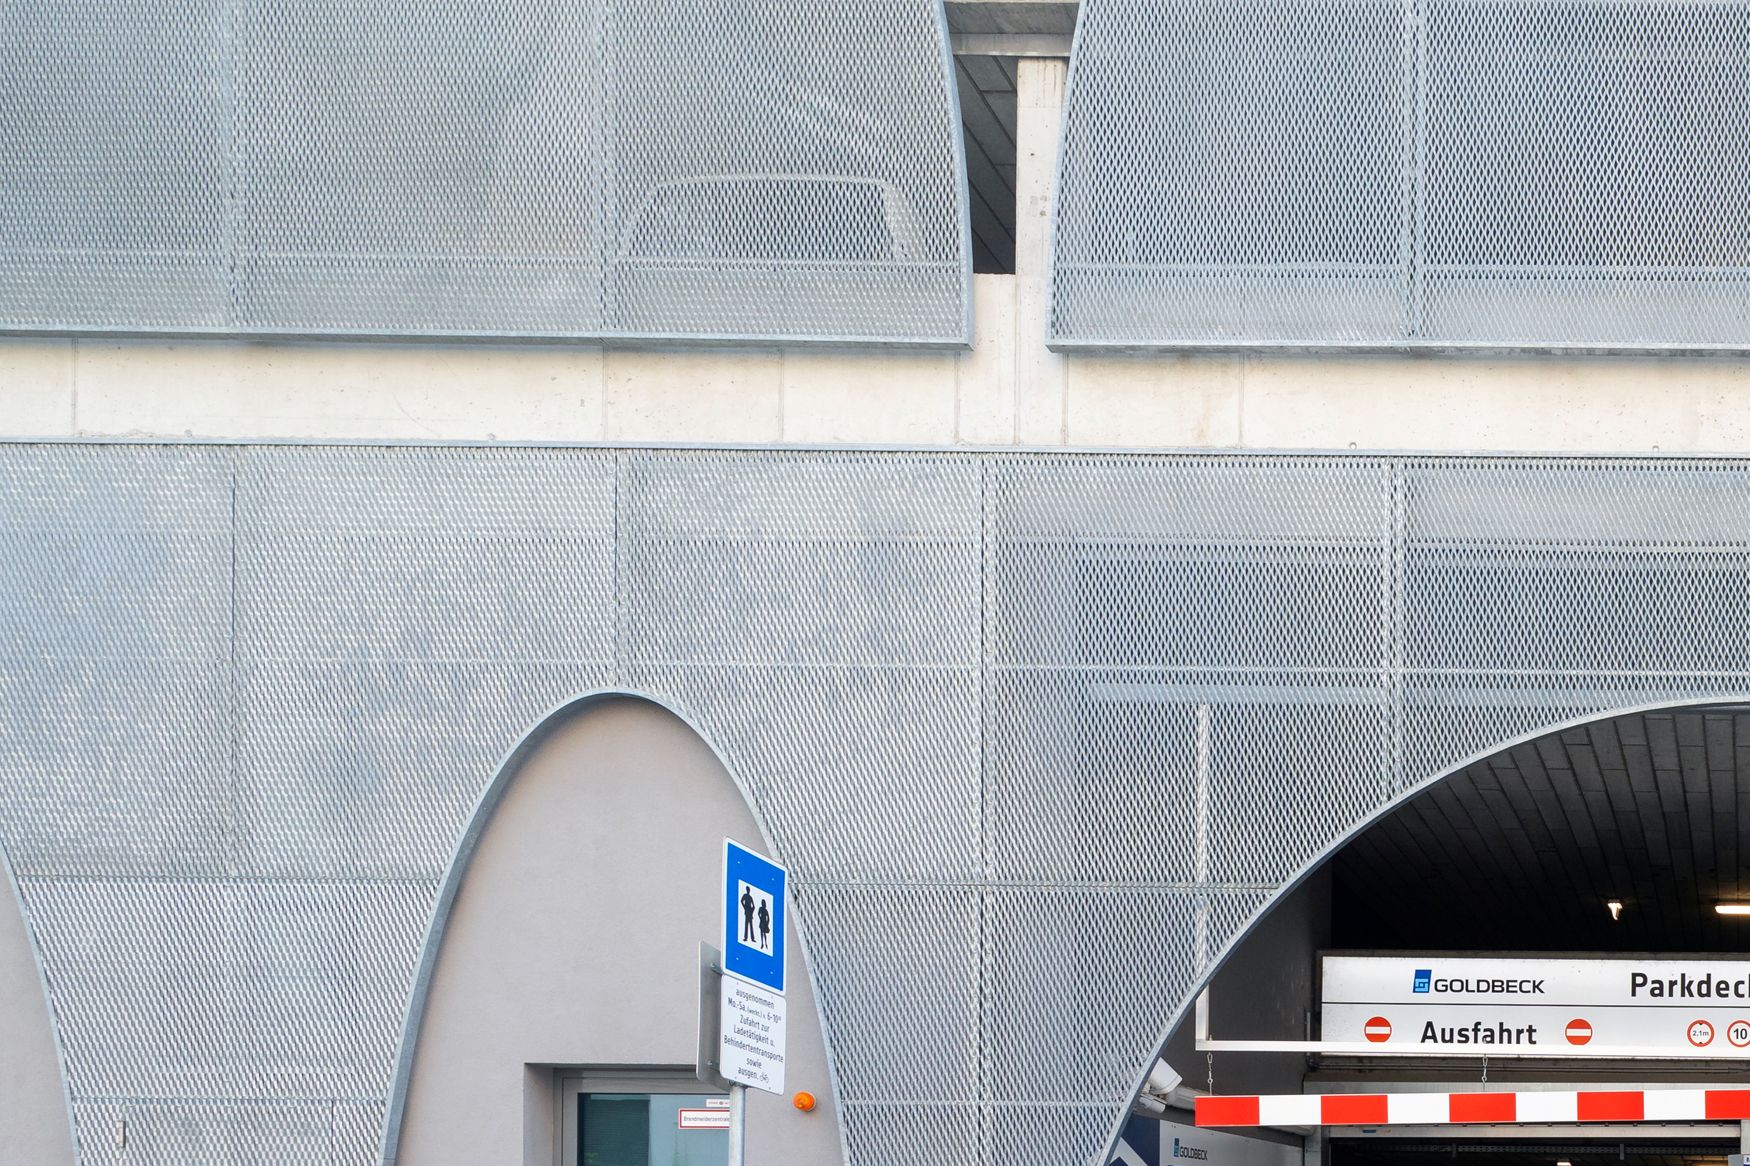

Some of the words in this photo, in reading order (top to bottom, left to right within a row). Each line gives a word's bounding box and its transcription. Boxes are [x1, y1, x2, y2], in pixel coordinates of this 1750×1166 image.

[1434, 979, 1546, 994] GOLDBECK
[735, 988, 775, 1010] ausgenommen
[739, 1014, 761, 1029] Zufahrt
[760, 1023, 770, 1033] zur
[733, 1024, 769, 1044] Ladetätigkeit
[1420, 1020, 1538, 1045] Ausfahrt
[1733, 1028, 1748, 1040] 10
[723, 1034, 784, 1063] Behindertentransporte
[746, 1058, 762, 1069] sowie
[737, 1067, 759, 1081] ausgen.
[1179, 1146, 1208, 1161] GOLDBECK
